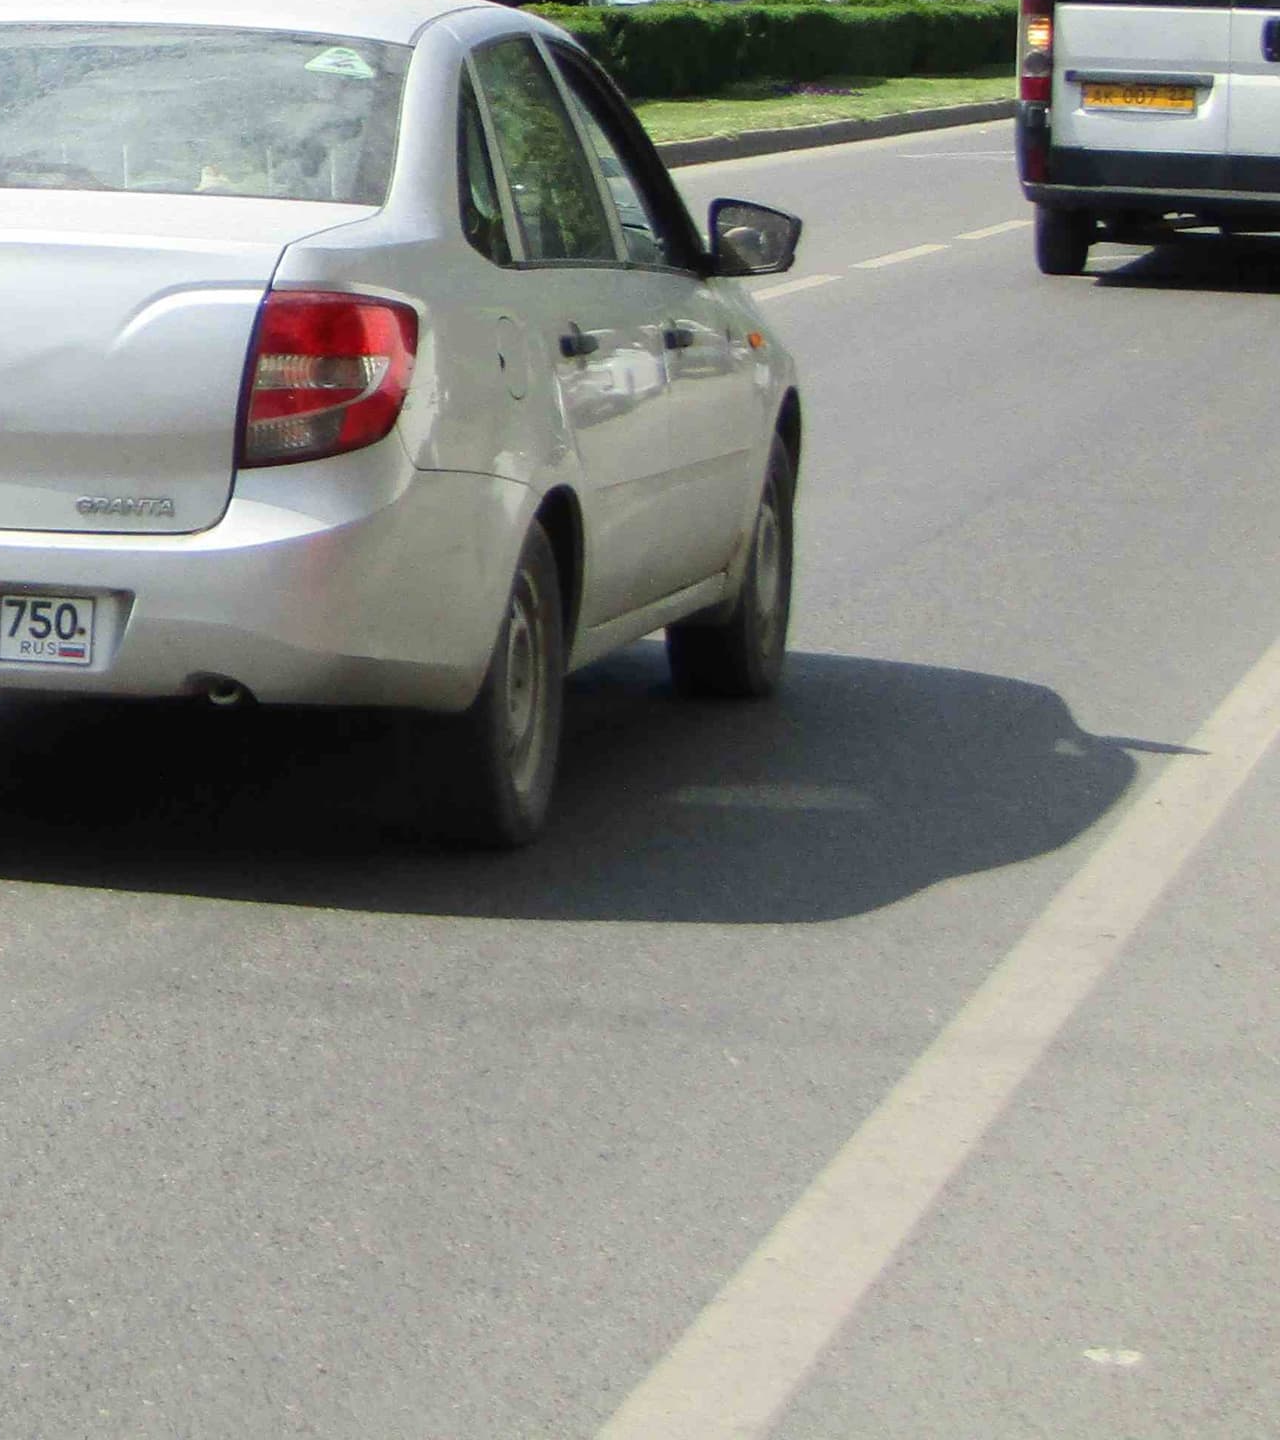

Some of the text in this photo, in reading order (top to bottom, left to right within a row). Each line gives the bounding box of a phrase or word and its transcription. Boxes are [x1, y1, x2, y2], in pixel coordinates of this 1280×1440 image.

[1123, 88, 1157, 104] 007
[5, 599, 78, 640] 750
[20, 641, 57, 657] RUS
